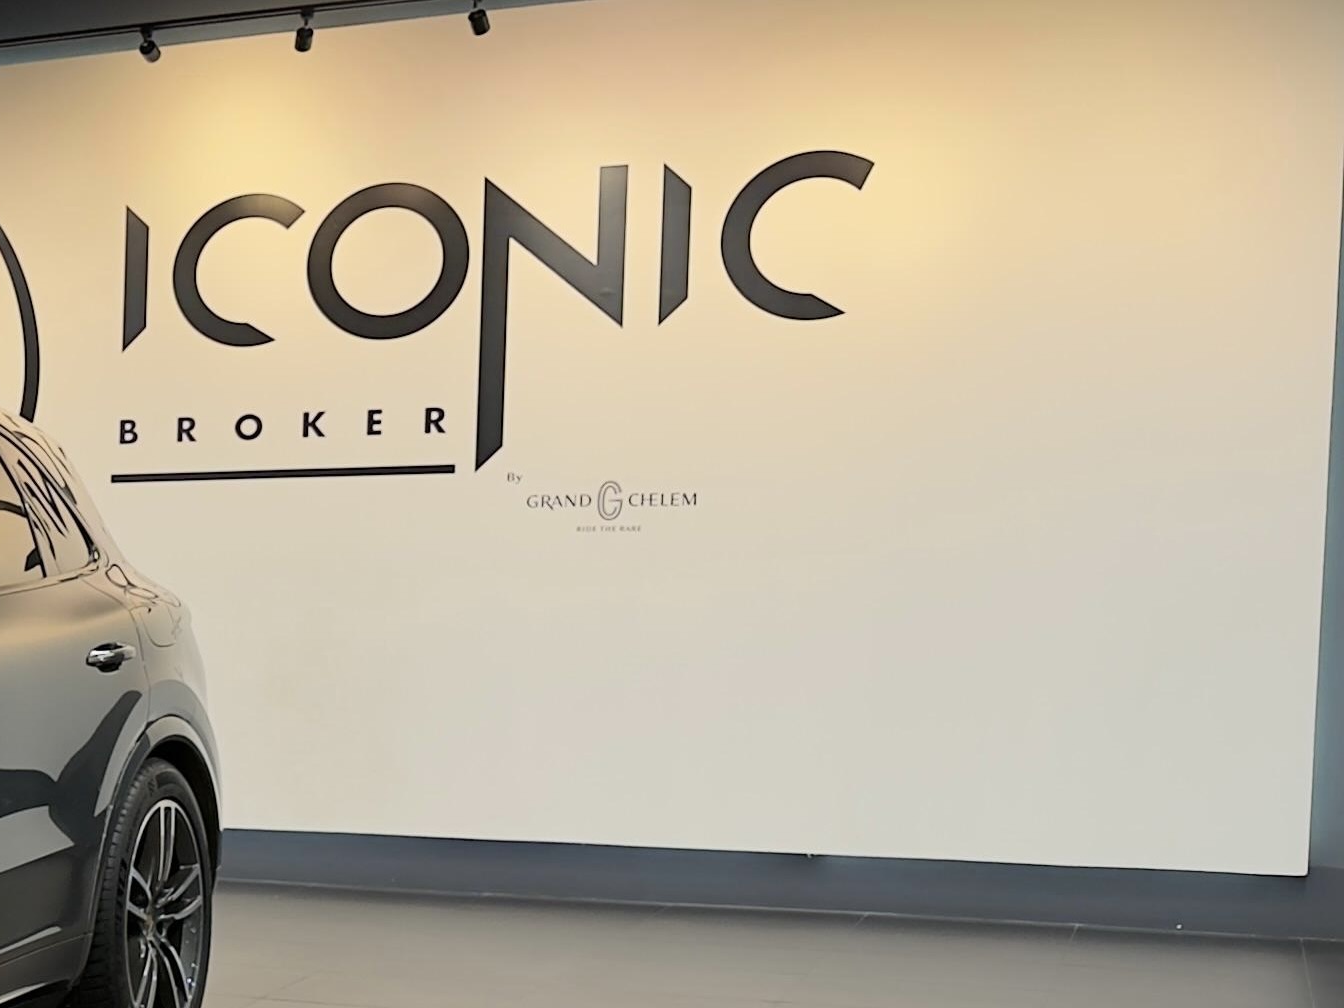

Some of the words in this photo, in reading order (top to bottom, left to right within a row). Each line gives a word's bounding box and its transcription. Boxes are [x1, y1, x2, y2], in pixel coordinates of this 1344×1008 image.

[122, 150, 875, 472] ICONIC
[119, 407, 446, 445] BROKER
[506, 472, 523, 484] By
[525, 494, 593, 510] GRAND
[628, 492, 698, 507] CHELEM
[600, 525, 616, 533] THE
